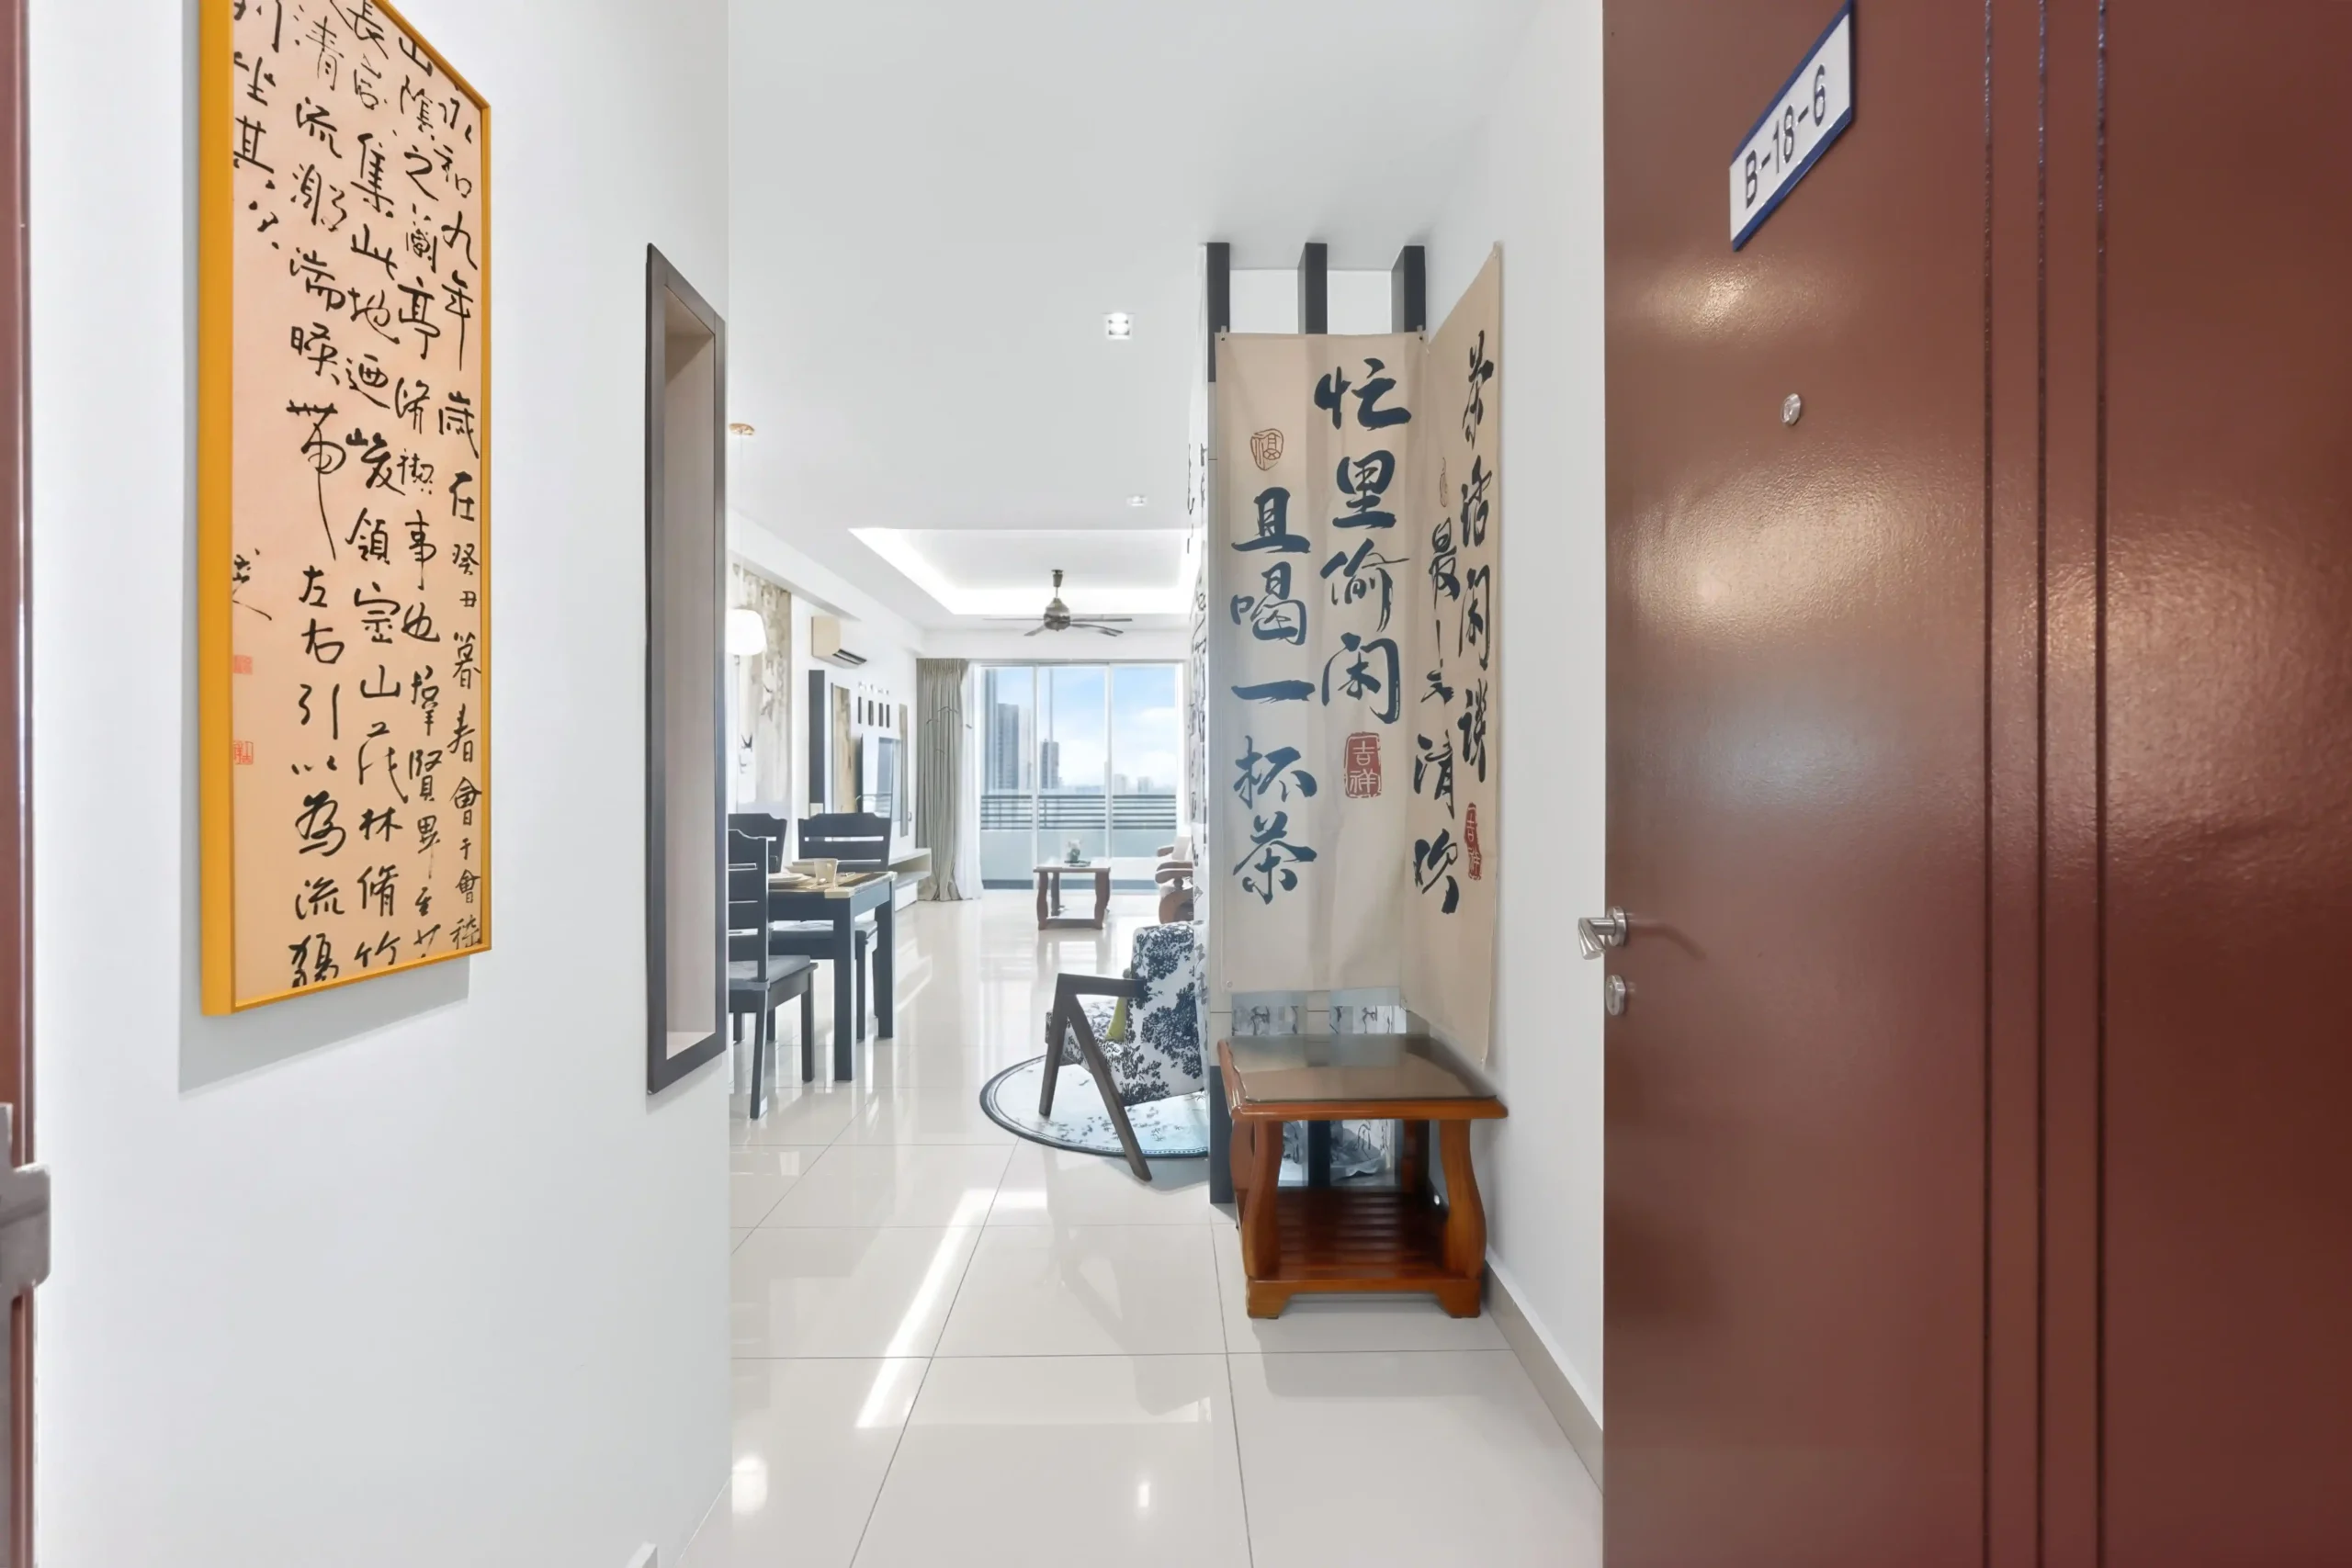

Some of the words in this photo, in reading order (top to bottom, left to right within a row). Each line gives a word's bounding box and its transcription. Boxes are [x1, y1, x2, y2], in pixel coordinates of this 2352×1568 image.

[1745, 63, 1826, 209] B-18-6
[1230, 486, 1317, 906] 且喝一杯茶
[1314, 357, 1412, 725] 忙里偷闲
